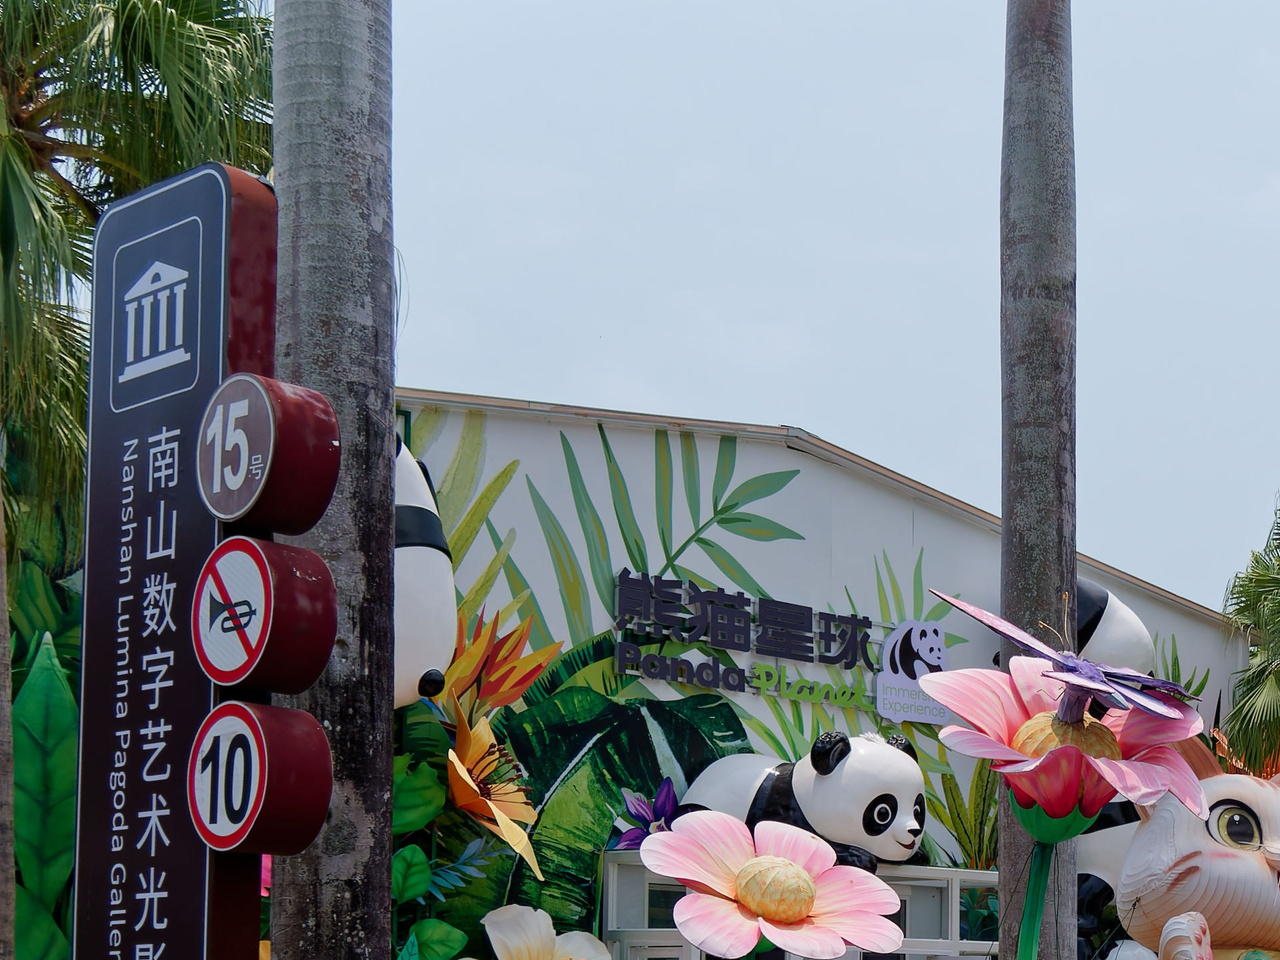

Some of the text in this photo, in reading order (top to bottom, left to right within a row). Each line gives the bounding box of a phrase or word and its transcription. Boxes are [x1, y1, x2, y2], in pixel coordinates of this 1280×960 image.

[206, 398, 264, 494] 15号
[118, 438, 139, 585] Nanshan
[115, 594, 135, 719] Lumina
[615, 566, 876, 673] 熊猫星球
[617, 641, 876, 712] Panda Planet
[881, 697, 946, 718] Experience
[109, 729, 131, 852] Pagoda
[200, 733, 253, 825] 10
